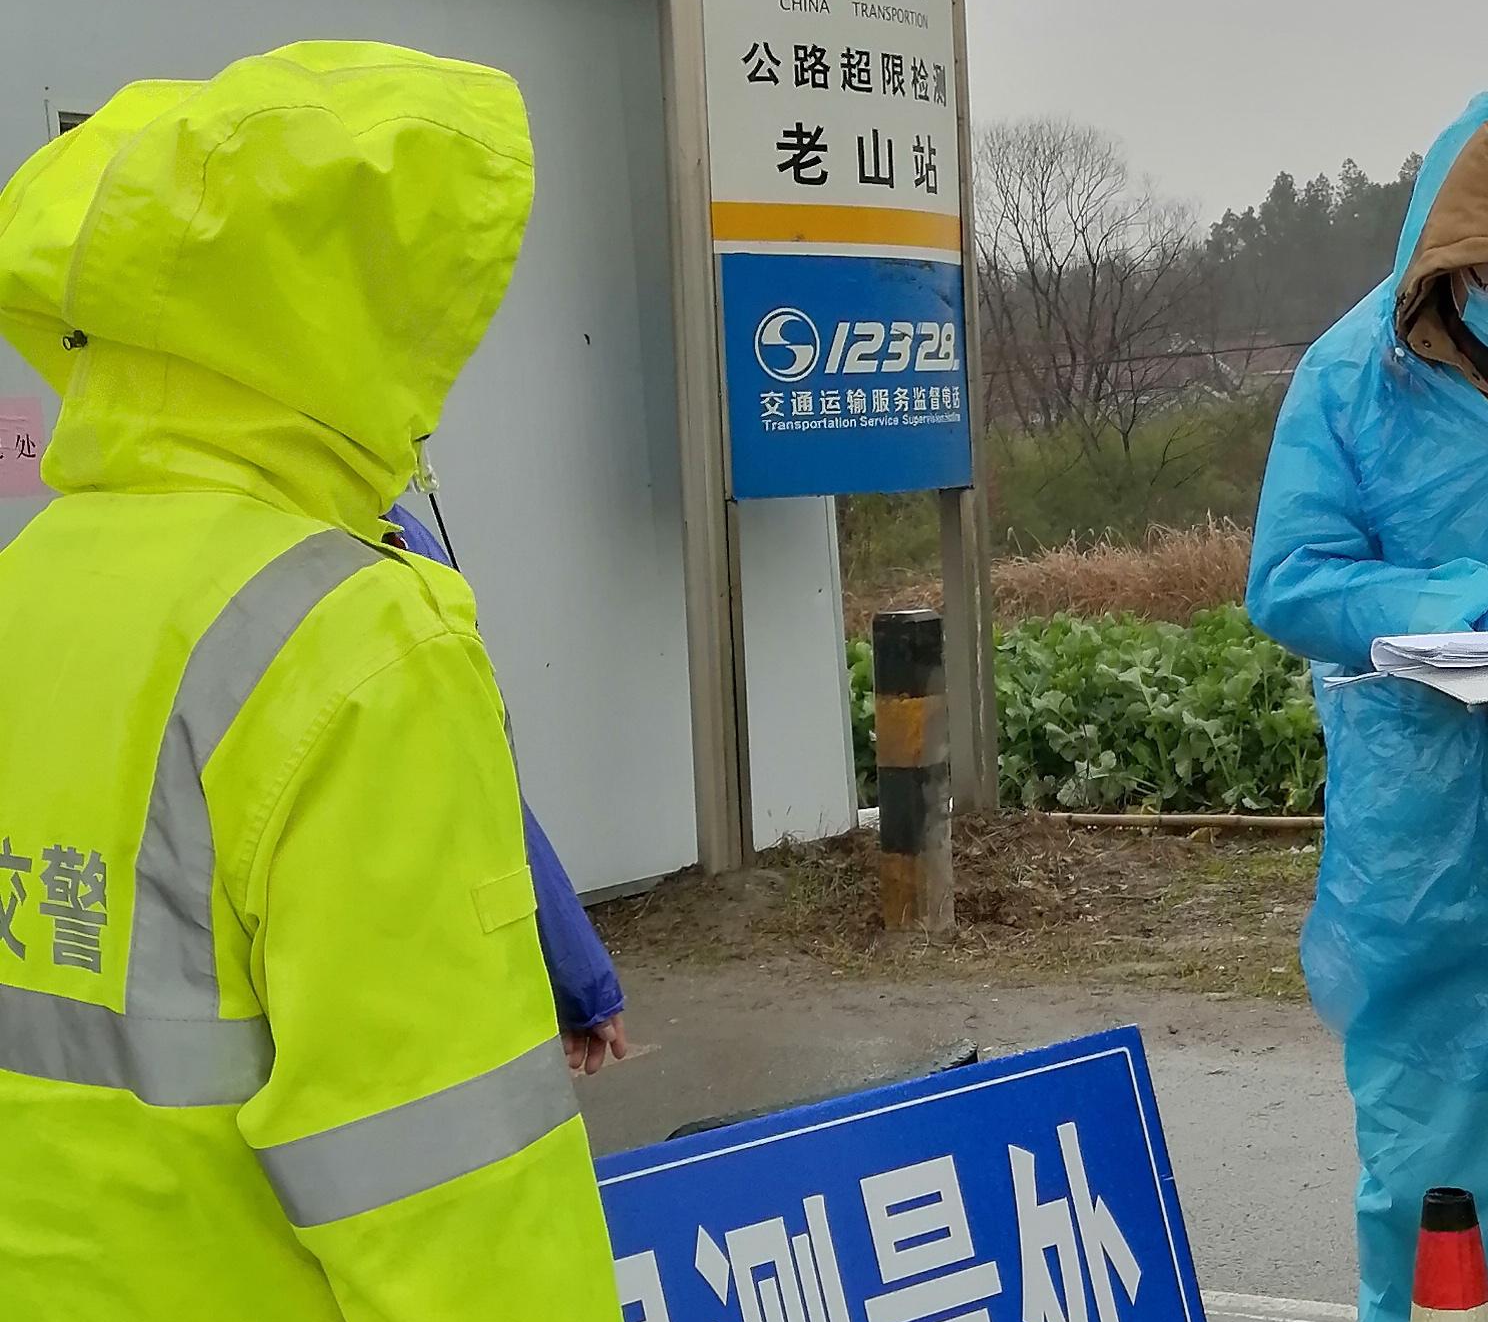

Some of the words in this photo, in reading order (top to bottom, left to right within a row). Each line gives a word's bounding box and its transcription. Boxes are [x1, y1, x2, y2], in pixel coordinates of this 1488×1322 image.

[852, 1, 929, 29] TRANSPORTION
[741, 41, 947, 107] 公路超限检测
[776, 122, 938, 195] 老山站
[824, 322, 958, 374] 12328
[760, 385, 960, 418] 交通运输服务监督电话
[762, 416, 857, 432] Transportation
[860, 415, 899, 428] Service
